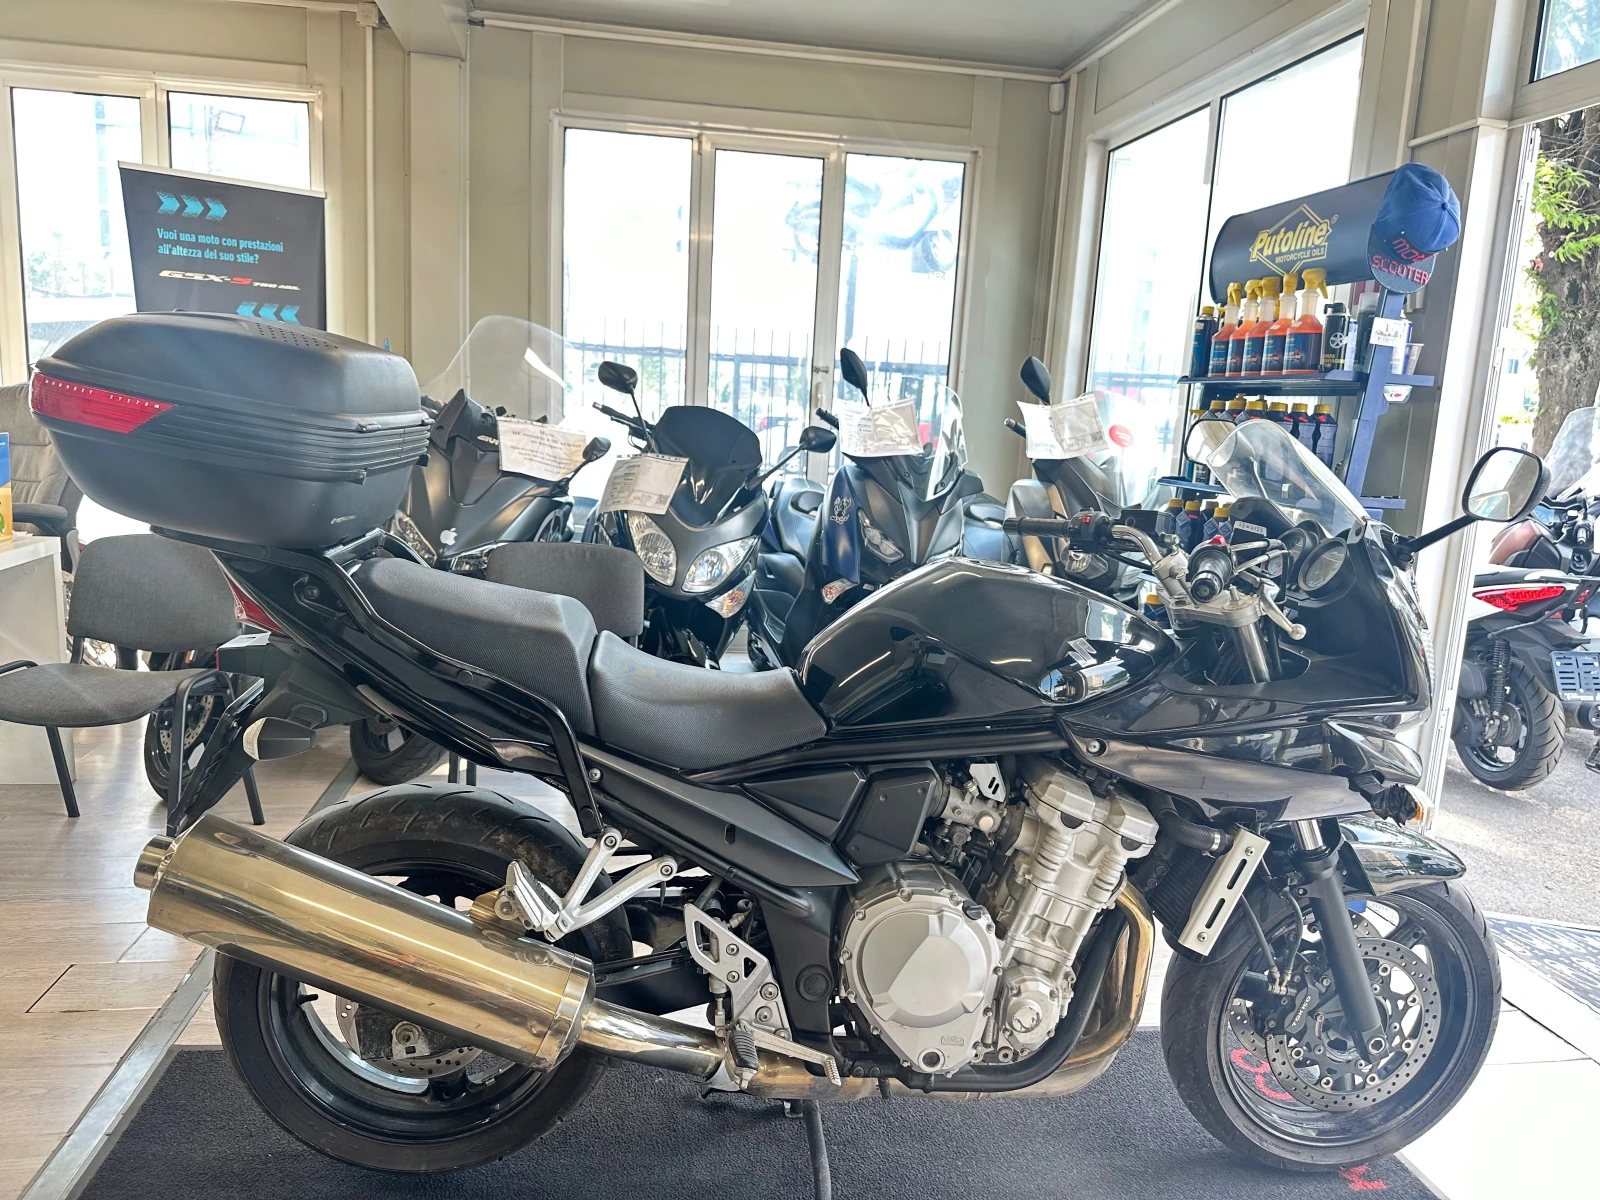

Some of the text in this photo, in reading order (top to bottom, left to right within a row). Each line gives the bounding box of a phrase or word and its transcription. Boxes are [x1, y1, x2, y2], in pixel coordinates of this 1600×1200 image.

[157, 228, 284, 252] Vuoi una moto con prestazioni
[1252, 221, 1328, 259] Putoline
[158, 244, 259, 264] all'altezza del suo stile?
[1275, 247, 1325, 264] MOTORCYCLE OILS
[1371, 255, 1429, 286] SCOOTER
[1291, 995, 1312, 1027] TOKICO
